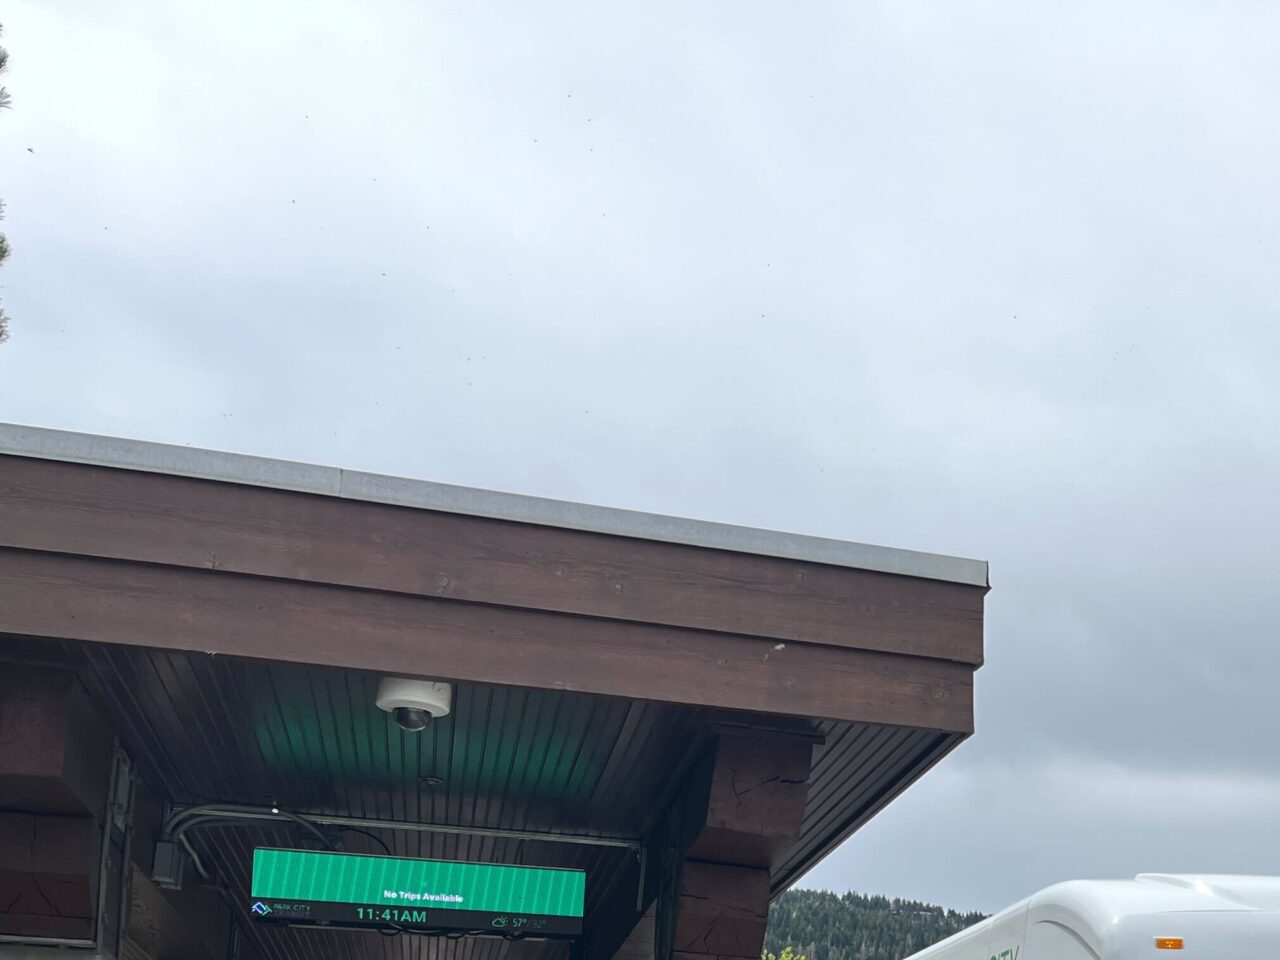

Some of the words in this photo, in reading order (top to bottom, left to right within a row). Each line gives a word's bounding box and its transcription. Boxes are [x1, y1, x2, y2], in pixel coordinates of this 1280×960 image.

[383, 889, 397, 899] No
[399, 890, 421, 901] Trips
[422, 891, 464, 903] Available
[357, 908, 427, 923] 11:41AM
